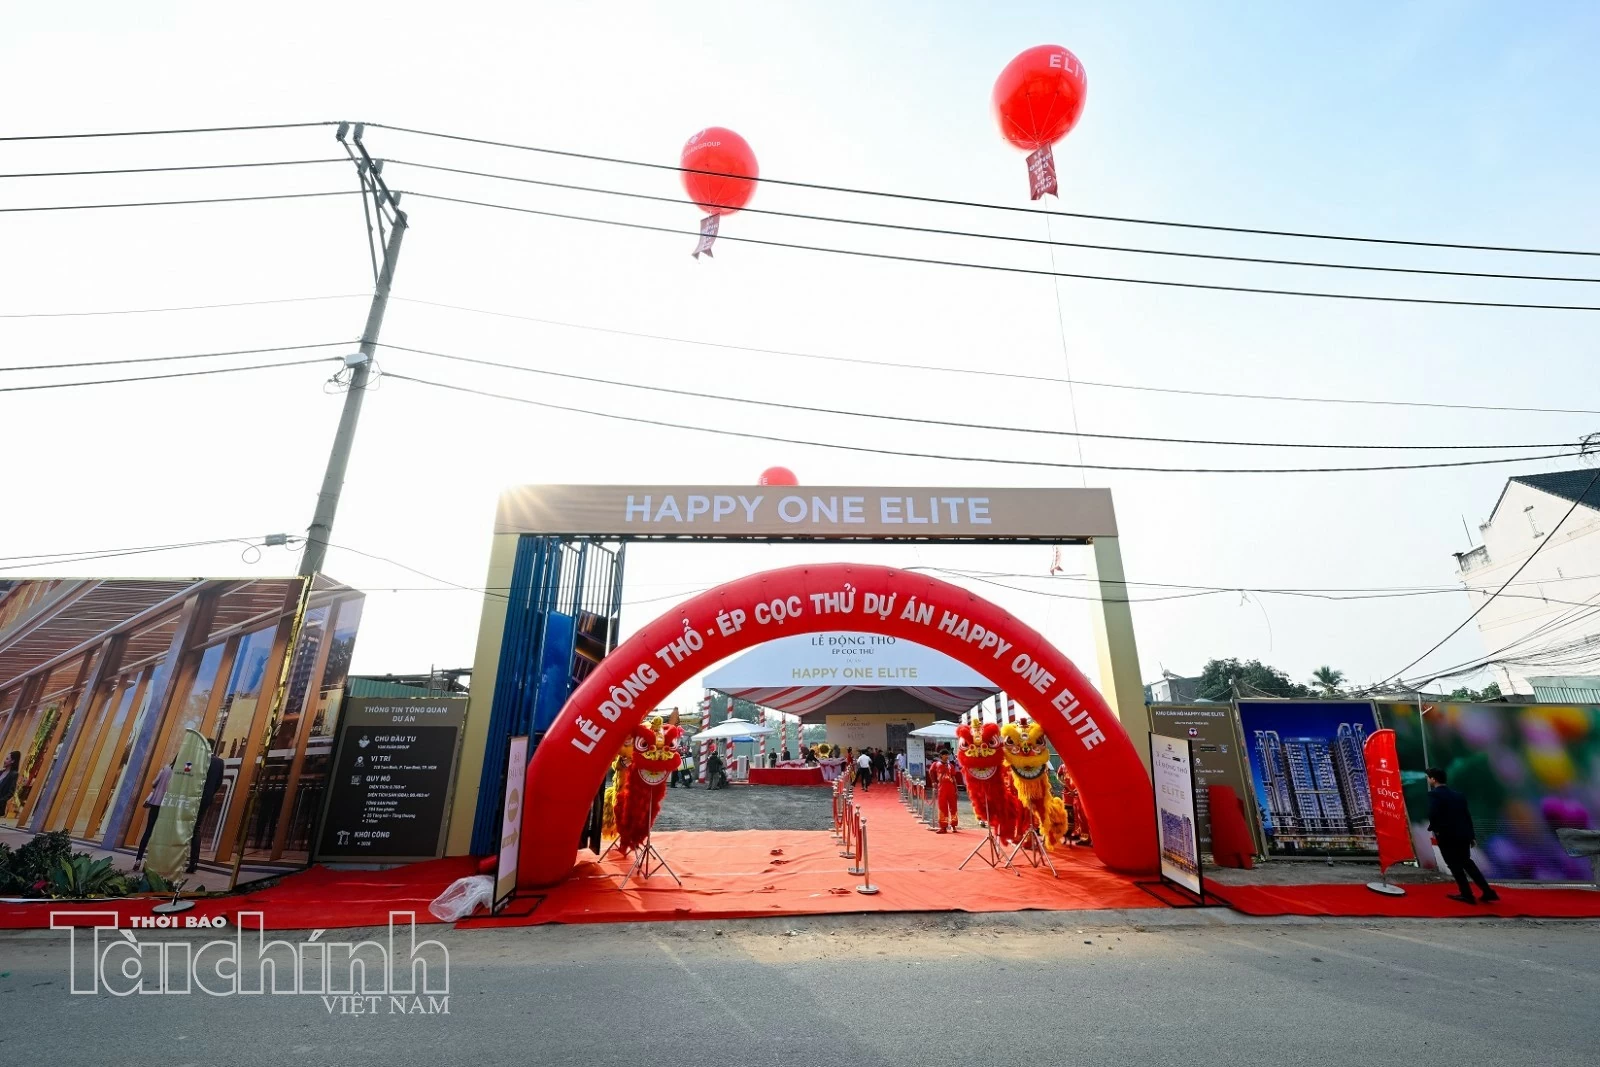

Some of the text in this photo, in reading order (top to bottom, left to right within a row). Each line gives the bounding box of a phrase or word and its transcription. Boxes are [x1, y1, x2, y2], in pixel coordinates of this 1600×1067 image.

[625, 495, 992, 524] HAPPY ONE ELITE
[828, 634, 866, 648] ĐỘNG
[571, 714, 607, 755] LỄ
[597, 663, 660, 723] ĐỘNG
[656, 618, 704, 668] THỔ
[715, 609, 747, 638] ÉP
[754, 595, 803, 625] CỌC
[809, 582, 857, 615] THỬ
[863, 592, 898, 620] DỰ
[899, 595, 936, 626] ÁN
[937, 609, 1014, 660] HAPPY
[1011, 653, 1057, 695] ONE
[1051, 688, 1107, 751] ELITE
[792, 667, 918, 679] HAPPY ONE ELITE
[391, 705, 403, 713] TIN
[426, 705, 448, 713] QUAN
[379, 754, 392, 762] TRÍ
[1161, 784, 1186, 800] ELITE
[161, 794, 191, 809] ELITE
[371, 830, 390, 838] CÔNG
